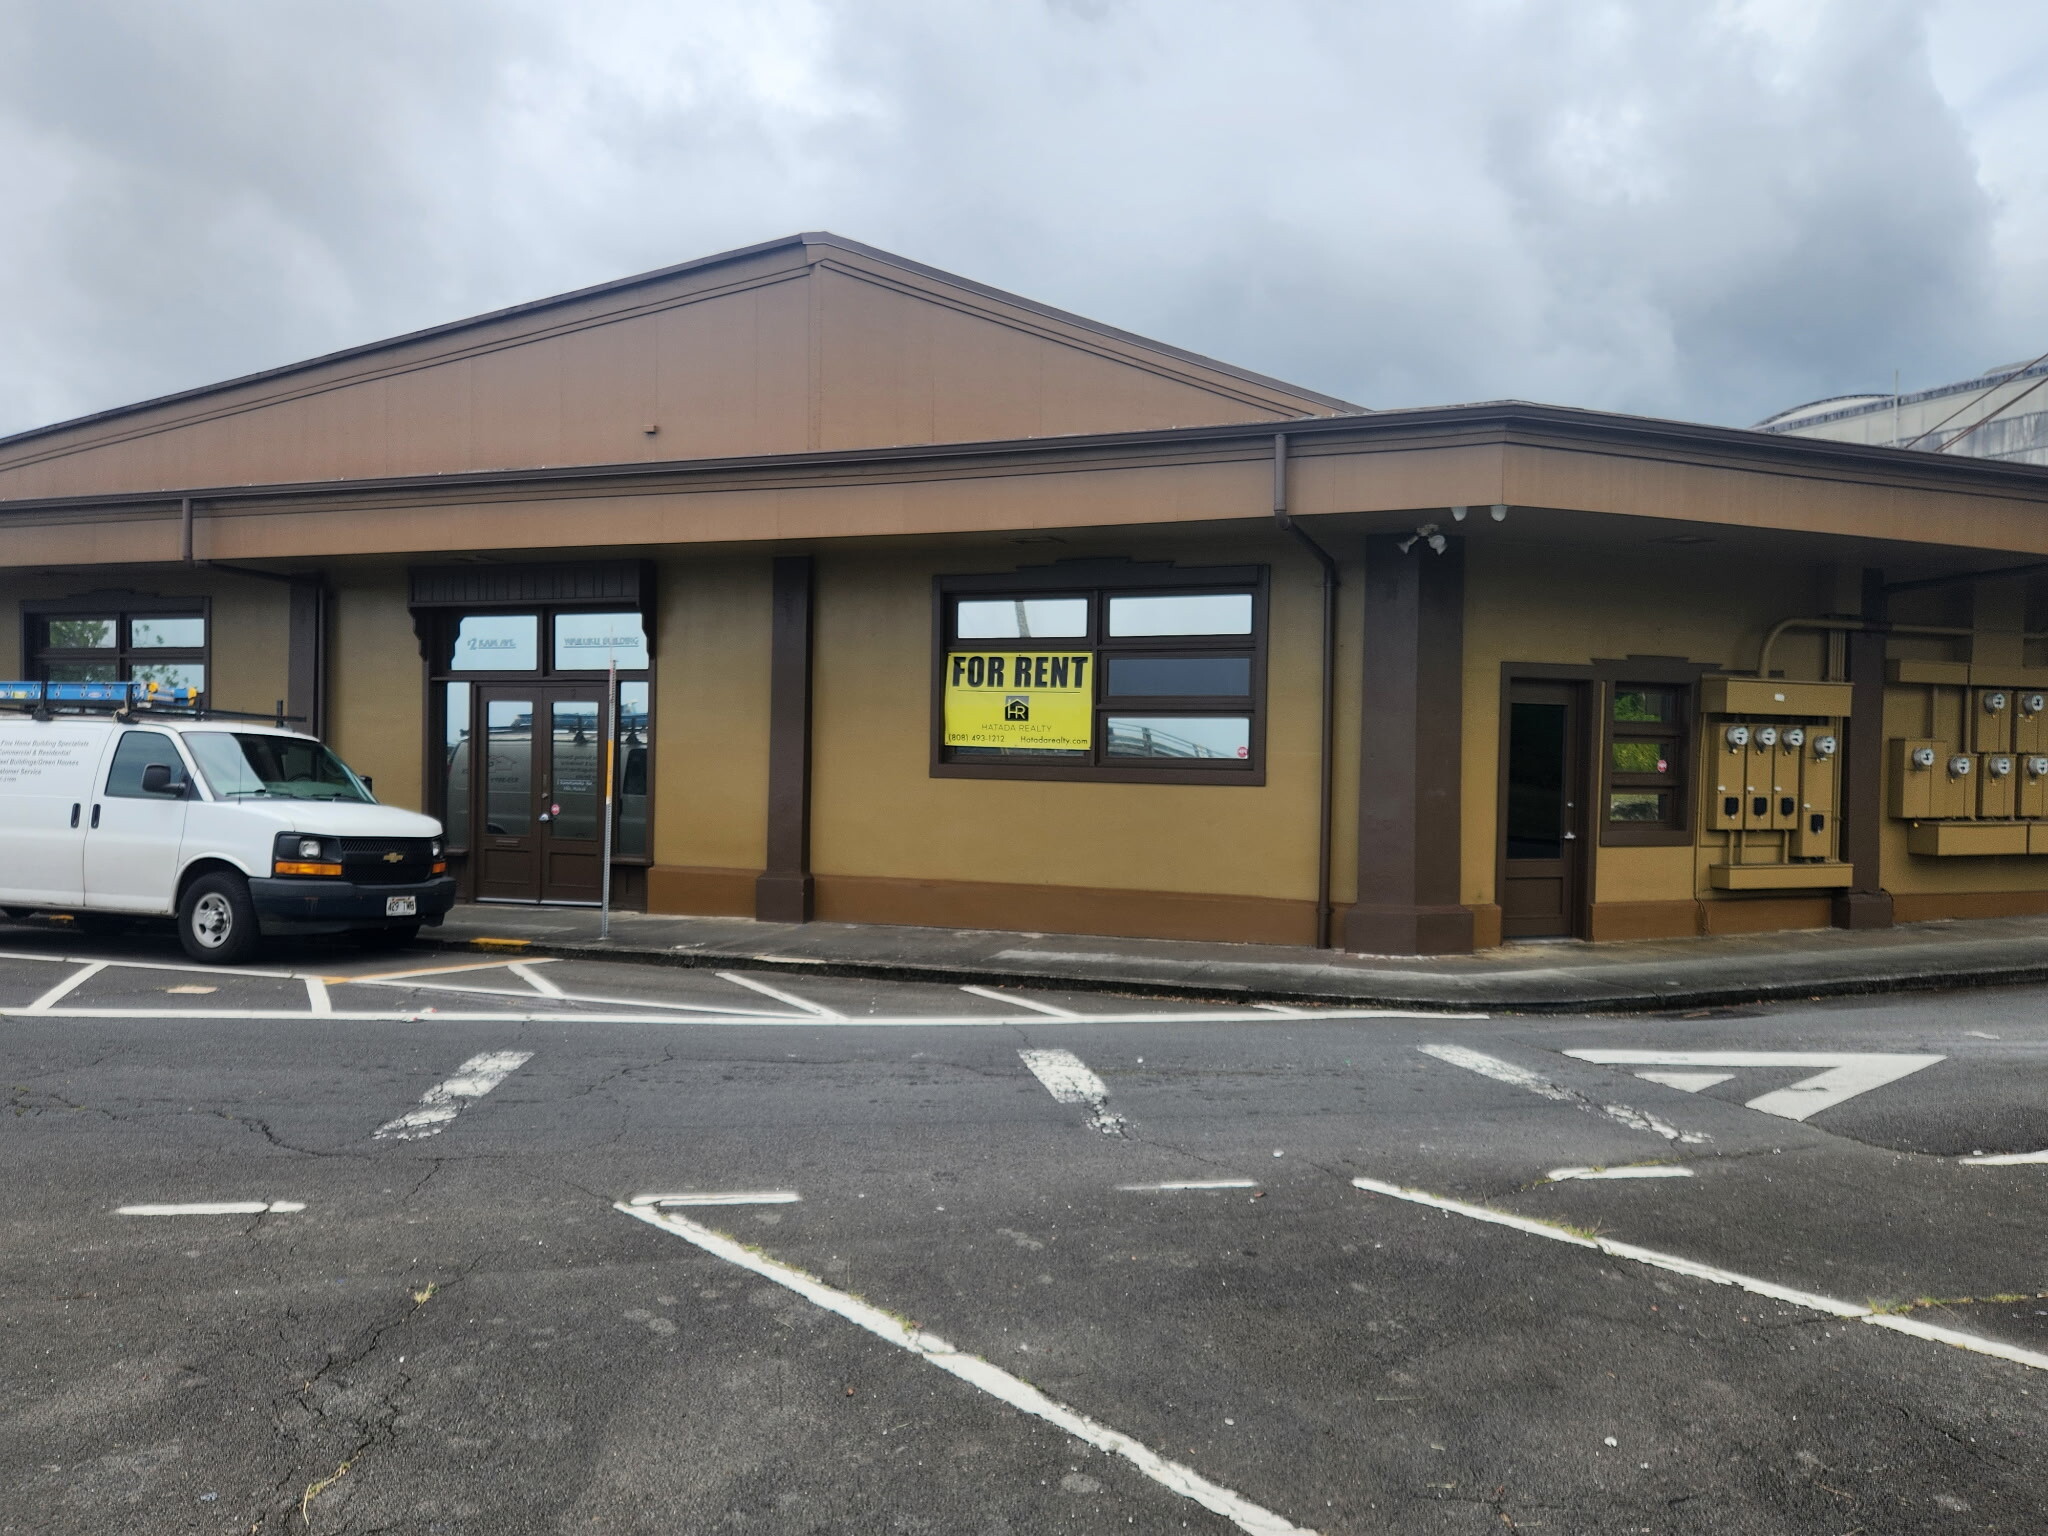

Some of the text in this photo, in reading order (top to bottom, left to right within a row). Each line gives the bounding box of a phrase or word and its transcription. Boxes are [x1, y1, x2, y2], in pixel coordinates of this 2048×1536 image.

[952, 656, 1088, 689] FOR RENT
[981, 724, 1052, 733] HATADA REALTY
[948, 733, 1005, 743] (808) 493-1212
[1020, 735, 1088, 745] Hatadarealty.com
[32, 740, 57, 748] Building
